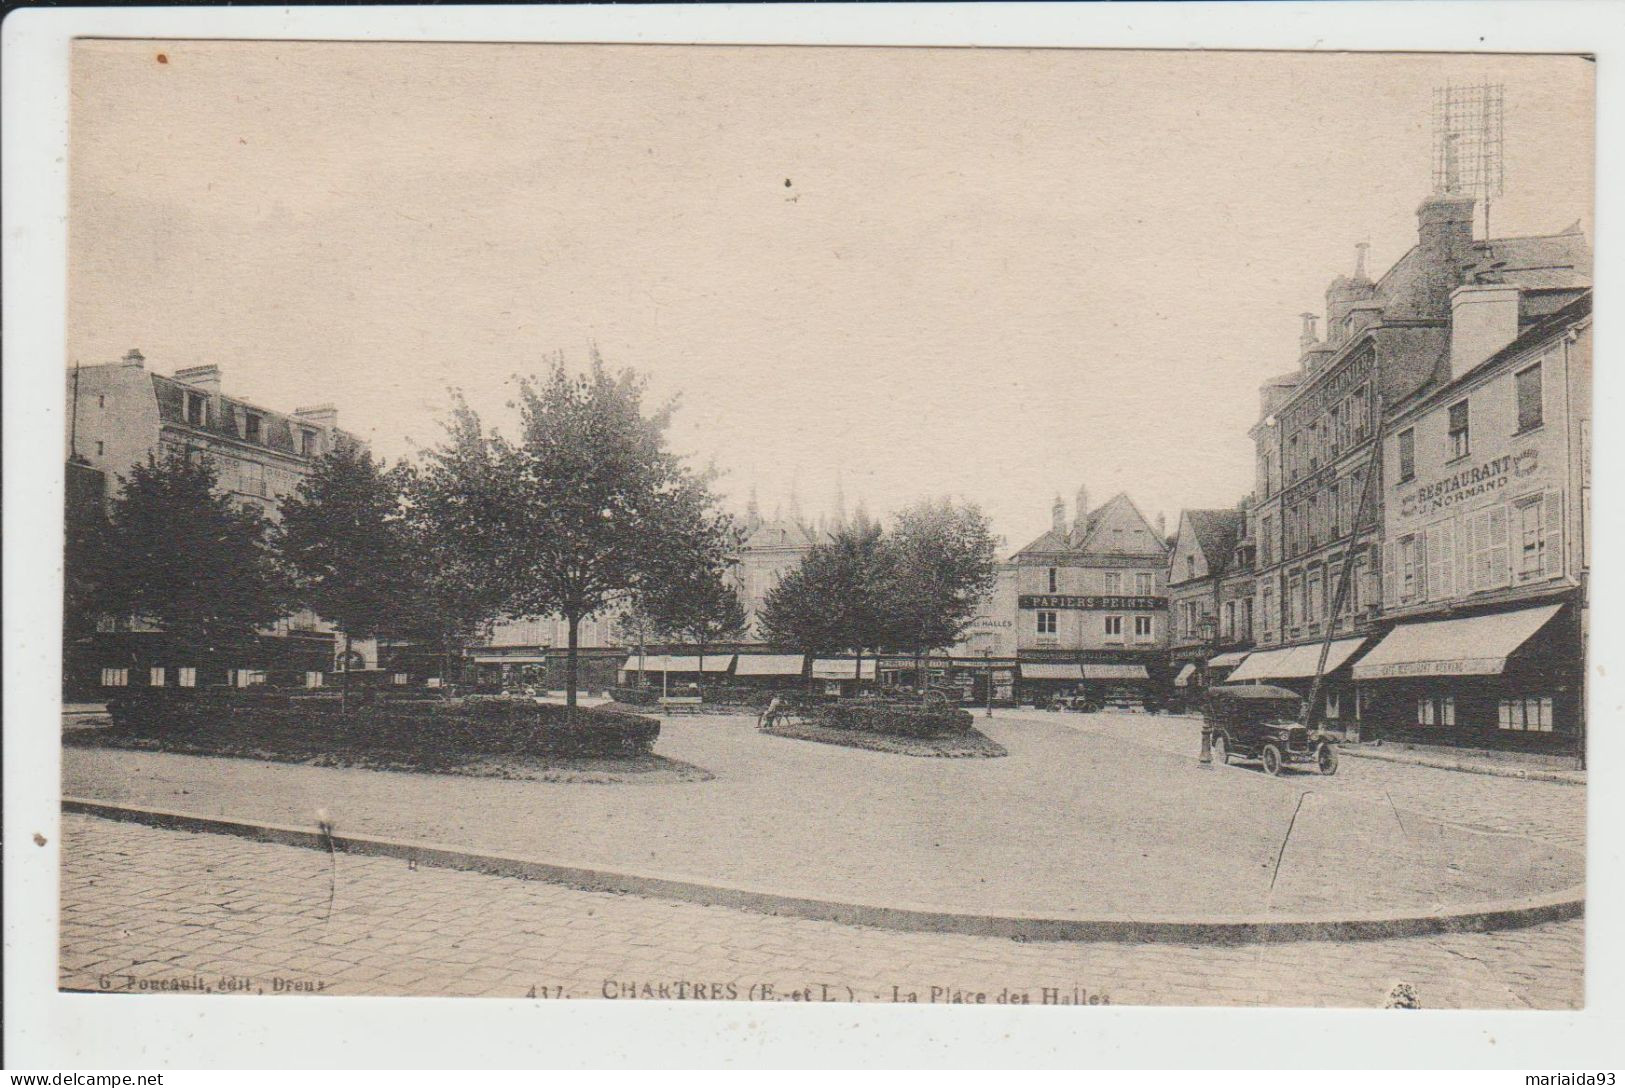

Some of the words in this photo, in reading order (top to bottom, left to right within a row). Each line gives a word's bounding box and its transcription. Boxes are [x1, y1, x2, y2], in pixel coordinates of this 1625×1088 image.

[1418, 455, 1511, 503] RESTAURANT
[1431, 476, 1508, 514] NORMAND
[1032, 597, 1094, 607] PAPIERS
[1102, 597, 1154, 608] PEINTS
[601, 979, 738, 1000] CHARTRES
[892, 985, 918, 1003] La
[930, 985, 987, 1005] Place
[996, 988, 1031, 1005] des
[1041, 986, 1111, 1006] Halles
